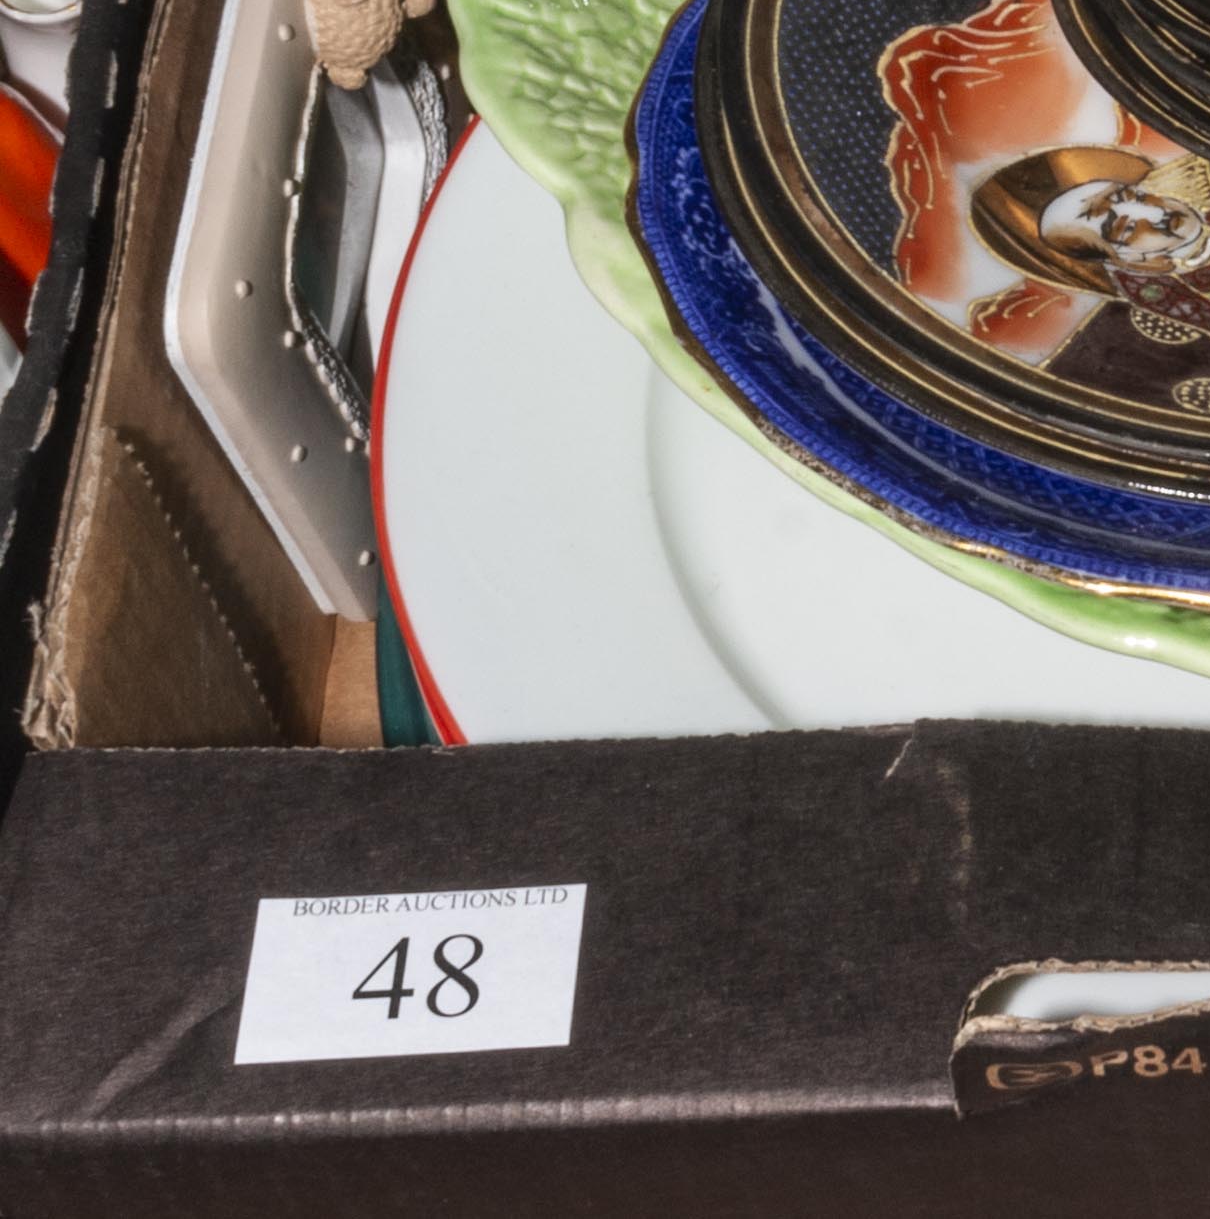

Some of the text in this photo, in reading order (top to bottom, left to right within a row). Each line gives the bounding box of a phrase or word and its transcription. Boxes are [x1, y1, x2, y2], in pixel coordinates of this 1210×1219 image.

[293, 886, 569, 917] BORDER AUCTIONS LTD
[352, 933, 484, 1020] 48
[1090, 1044, 1206, 1078] P84
